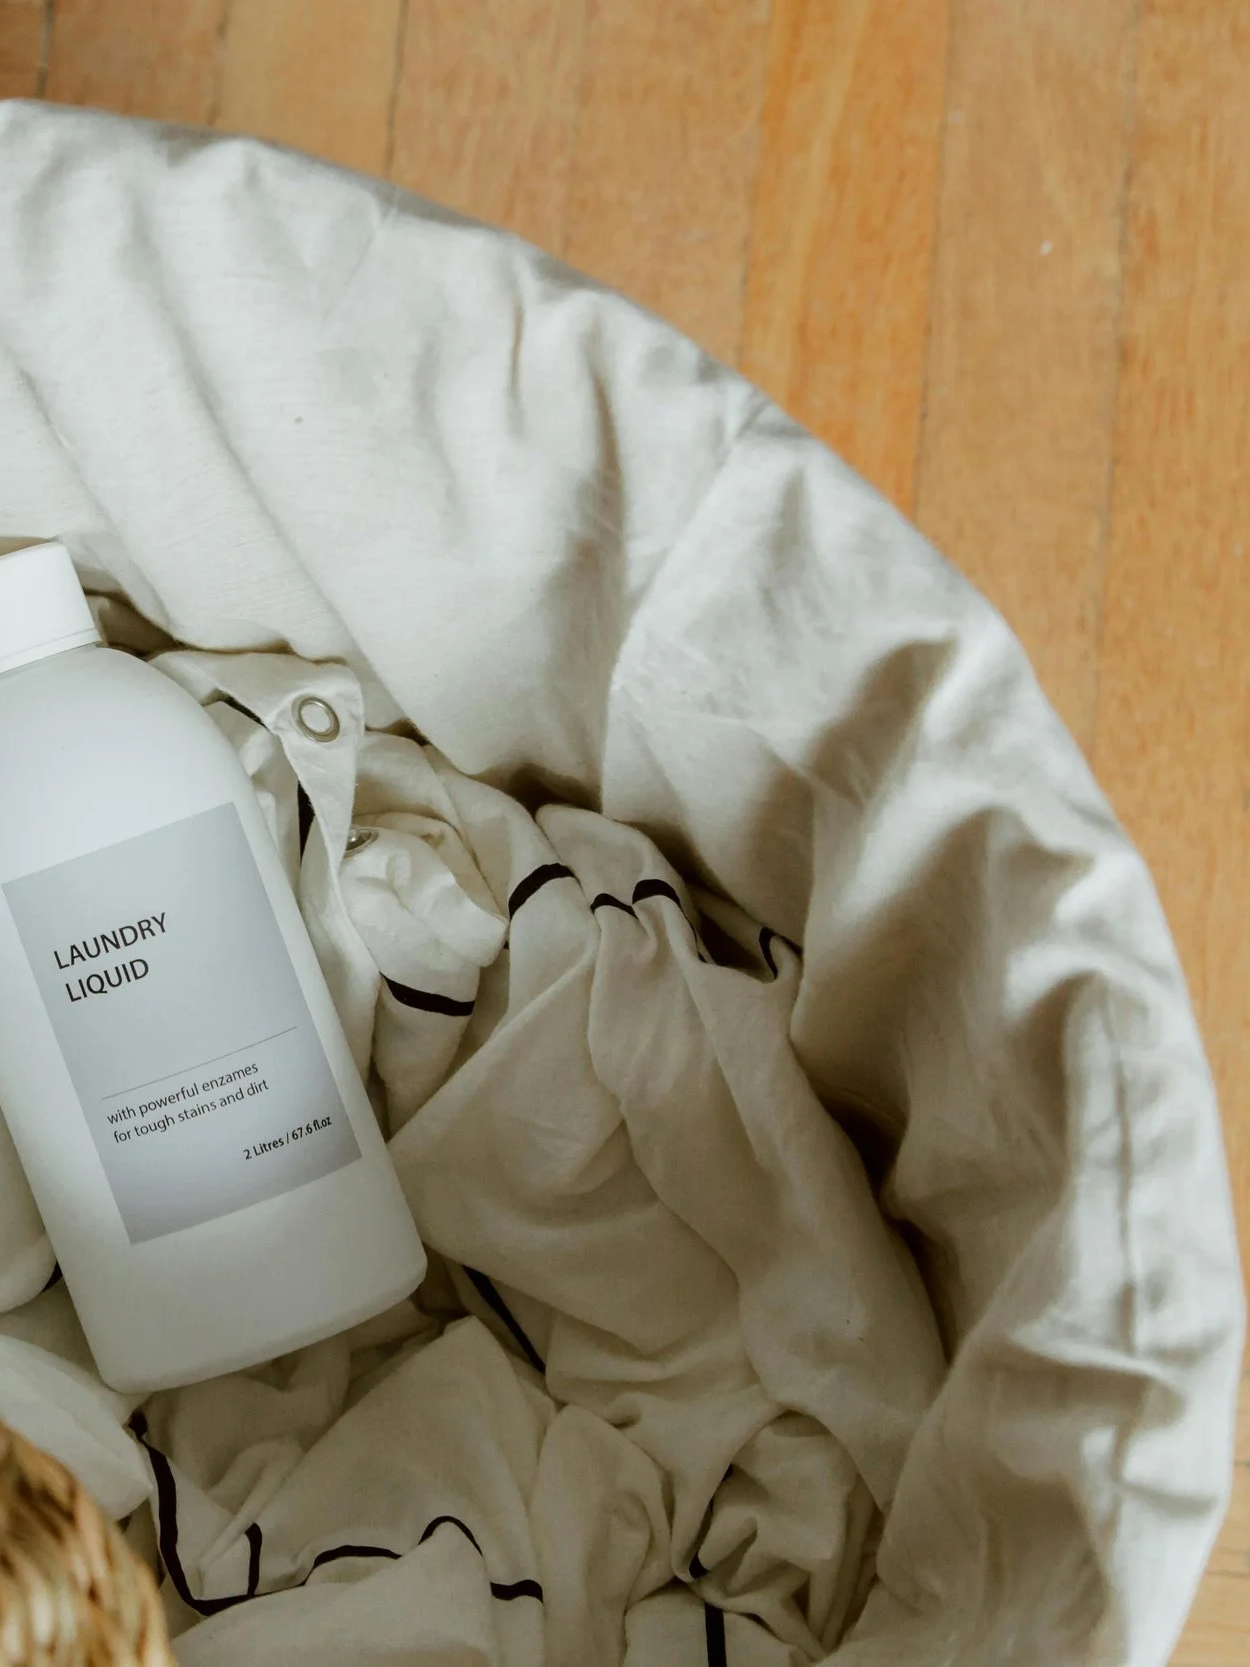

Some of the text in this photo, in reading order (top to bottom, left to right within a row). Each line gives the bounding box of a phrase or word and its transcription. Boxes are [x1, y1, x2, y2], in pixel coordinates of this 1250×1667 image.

[53, 911, 166, 970] LAUNDRY
[65, 958, 149, 1003] LIQUID
[106, 1062, 259, 1125] with powerful enzames
[113, 1078, 269, 1144] for tough stains and dirt
[243, 1116, 332, 1160] 2 Litres / 67.6 fl.oz
